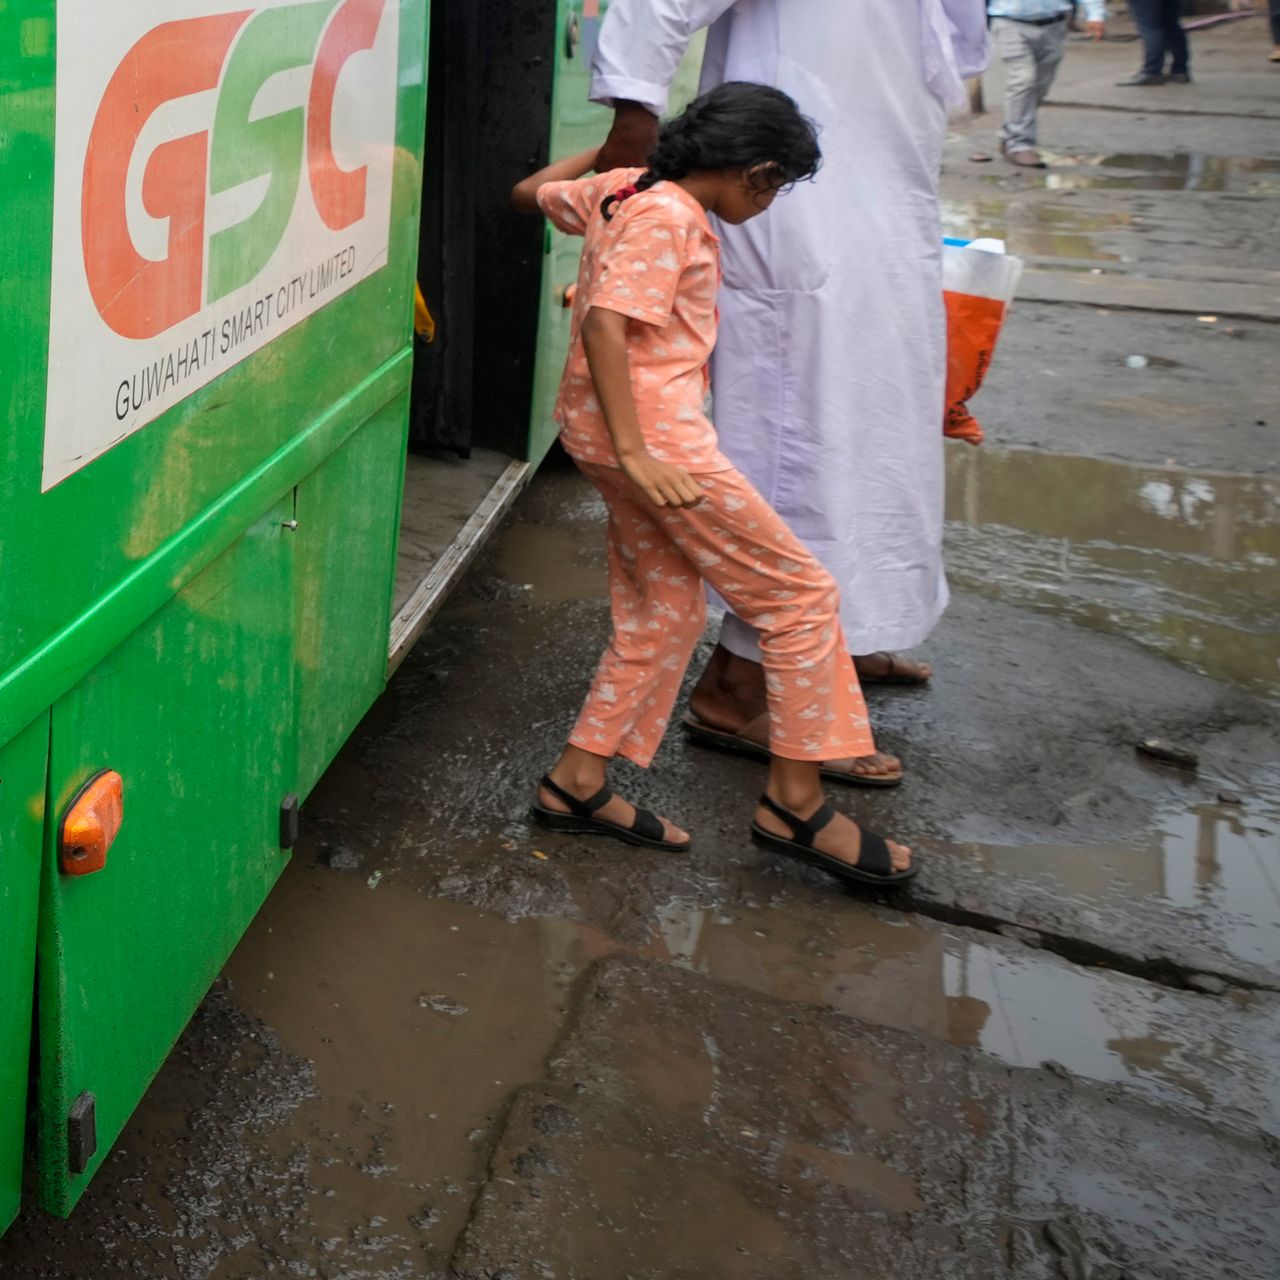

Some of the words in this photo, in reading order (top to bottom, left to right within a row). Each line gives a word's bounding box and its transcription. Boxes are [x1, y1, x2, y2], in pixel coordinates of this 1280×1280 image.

[115, 329, 217, 421] GUWAHATI
[220, 293, 274, 354] SMART
[276, 272, 309, 318] CITY
[309, 245, 356, 298] LIMITED
